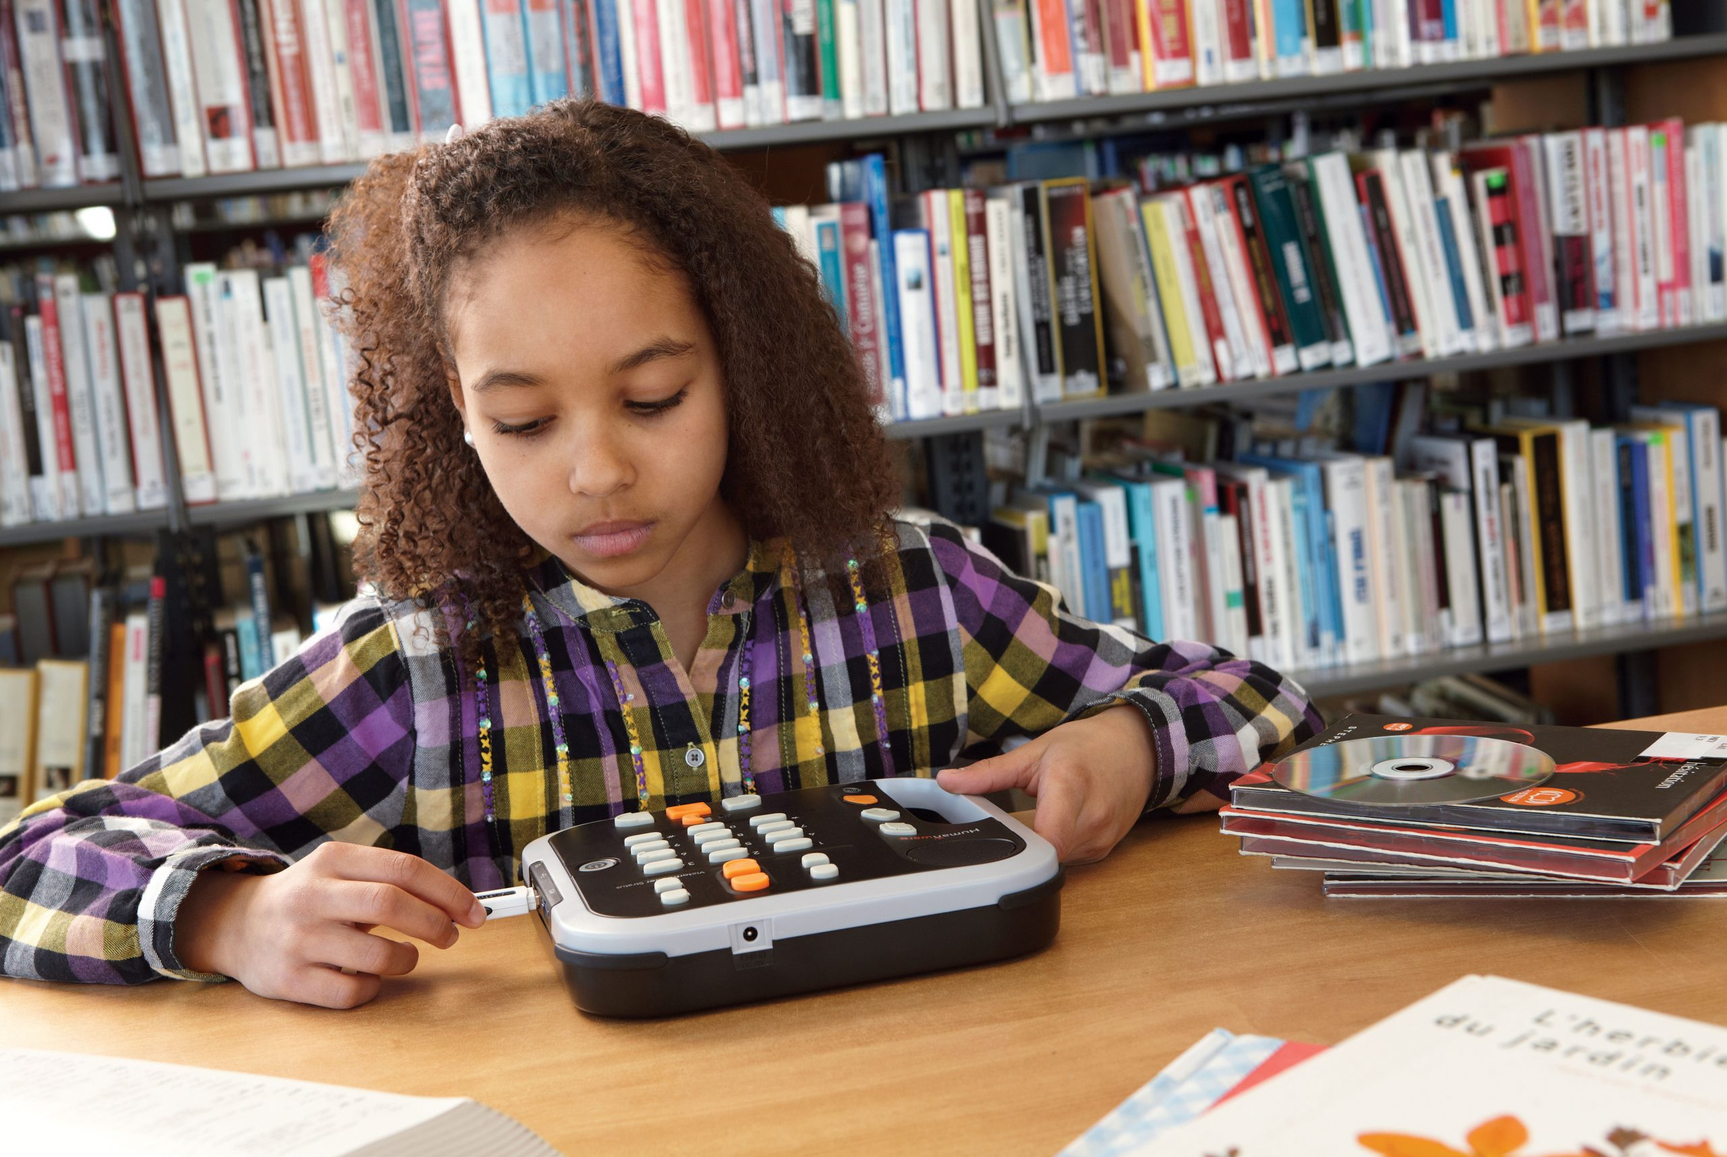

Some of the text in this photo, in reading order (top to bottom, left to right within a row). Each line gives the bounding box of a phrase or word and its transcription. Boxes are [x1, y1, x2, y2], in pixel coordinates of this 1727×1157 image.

[1655, 761, 1708, 789] hésitation
[1433, 1015, 1672, 1081] du jardin
